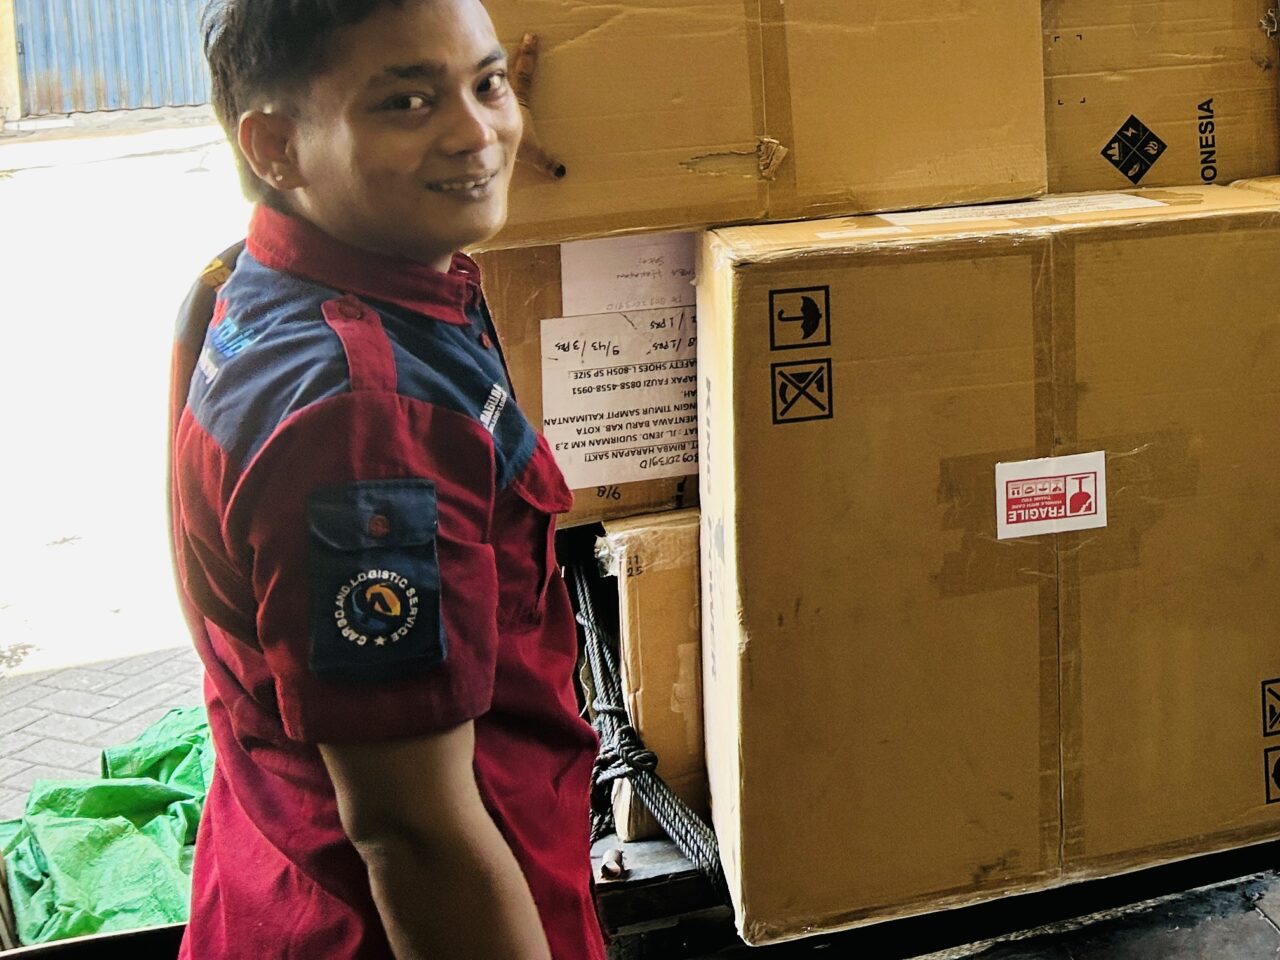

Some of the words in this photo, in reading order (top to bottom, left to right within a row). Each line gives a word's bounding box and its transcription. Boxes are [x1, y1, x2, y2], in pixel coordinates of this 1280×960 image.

[1198, 98, 1218, 184] ONESIA
[639, 362, 668, 372] SHOES
[668, 360, 696, 370] AFETY
[574, 371, 591, 380] SIZE
[594, 369, 605, 378] SP
[606, 366, 636, 376] L-805H
[572, 381, 642, 395] 0858-4558-0951
[643, 379, 669, 388] FAUZI
[606, 408, 640, 420] SAMPIT
[642, 406, 671, 415] TIMUR
[544, 412, 604, 426] KALIMANTAN
[576, 426, 600, 435] KOTA
[626, 422, 650, 430] BARU
[571, 440, 586, 448] KM
[588, 435, 638, 446] SUDIRMAN
[612, 445, 655, 458] HARAPAN
[656, 442, 686, 454] RIMBA
[584, 452, 610, 462] SAKTI
[1008, 506, 1065, 522] FRAGILE
[350, 569, 408, 589] LOGISTIC
[336, 586, 351, 608] AND
[390, 587, 418, 642] SERVICE
[334, 609, 368, 646] CARGO
